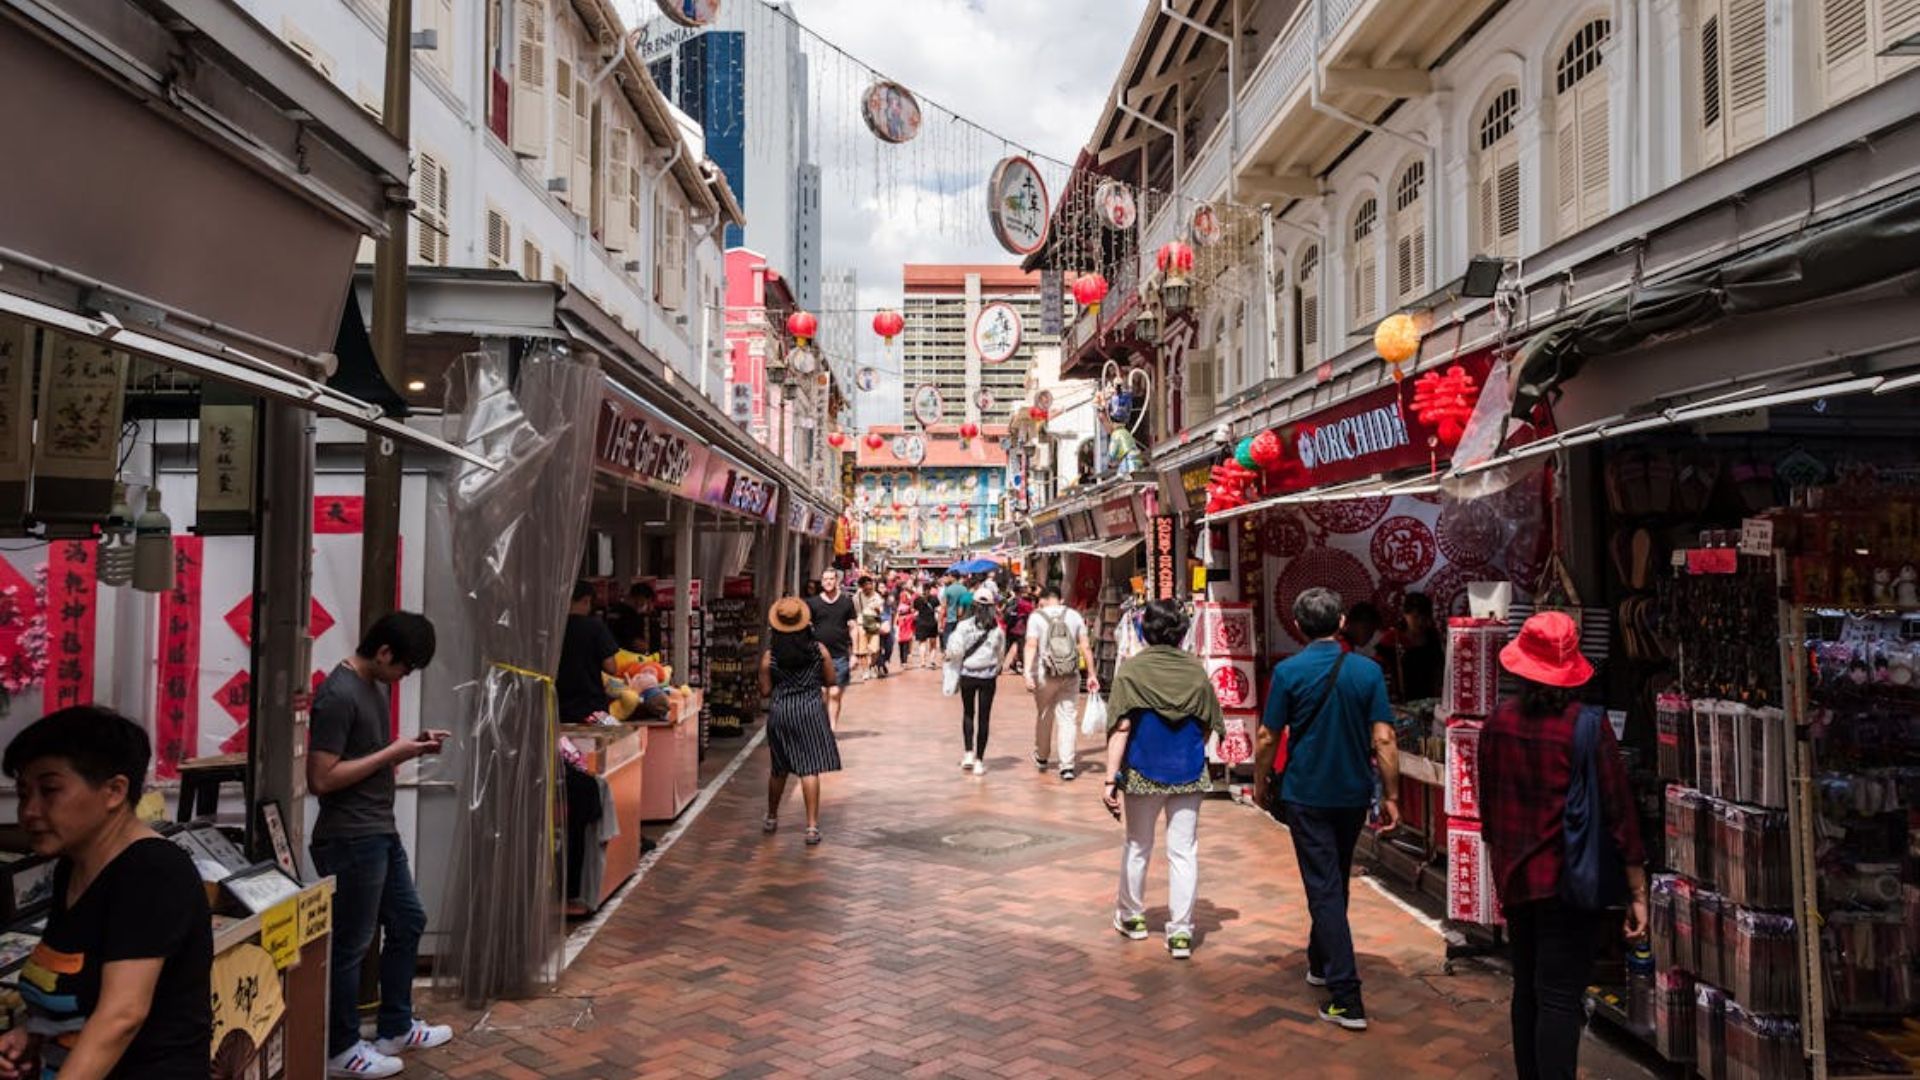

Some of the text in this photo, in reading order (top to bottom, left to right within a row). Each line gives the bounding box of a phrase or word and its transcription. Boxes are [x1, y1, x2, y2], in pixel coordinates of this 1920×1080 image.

[635, 23, 696, 57] PERENNIAL
[603, 401, 693, 485] THE GIFT SHOP
[1314, 403, 1409, 465] ORCHIDA
[1156, 517, 1172, 555] MONEY
